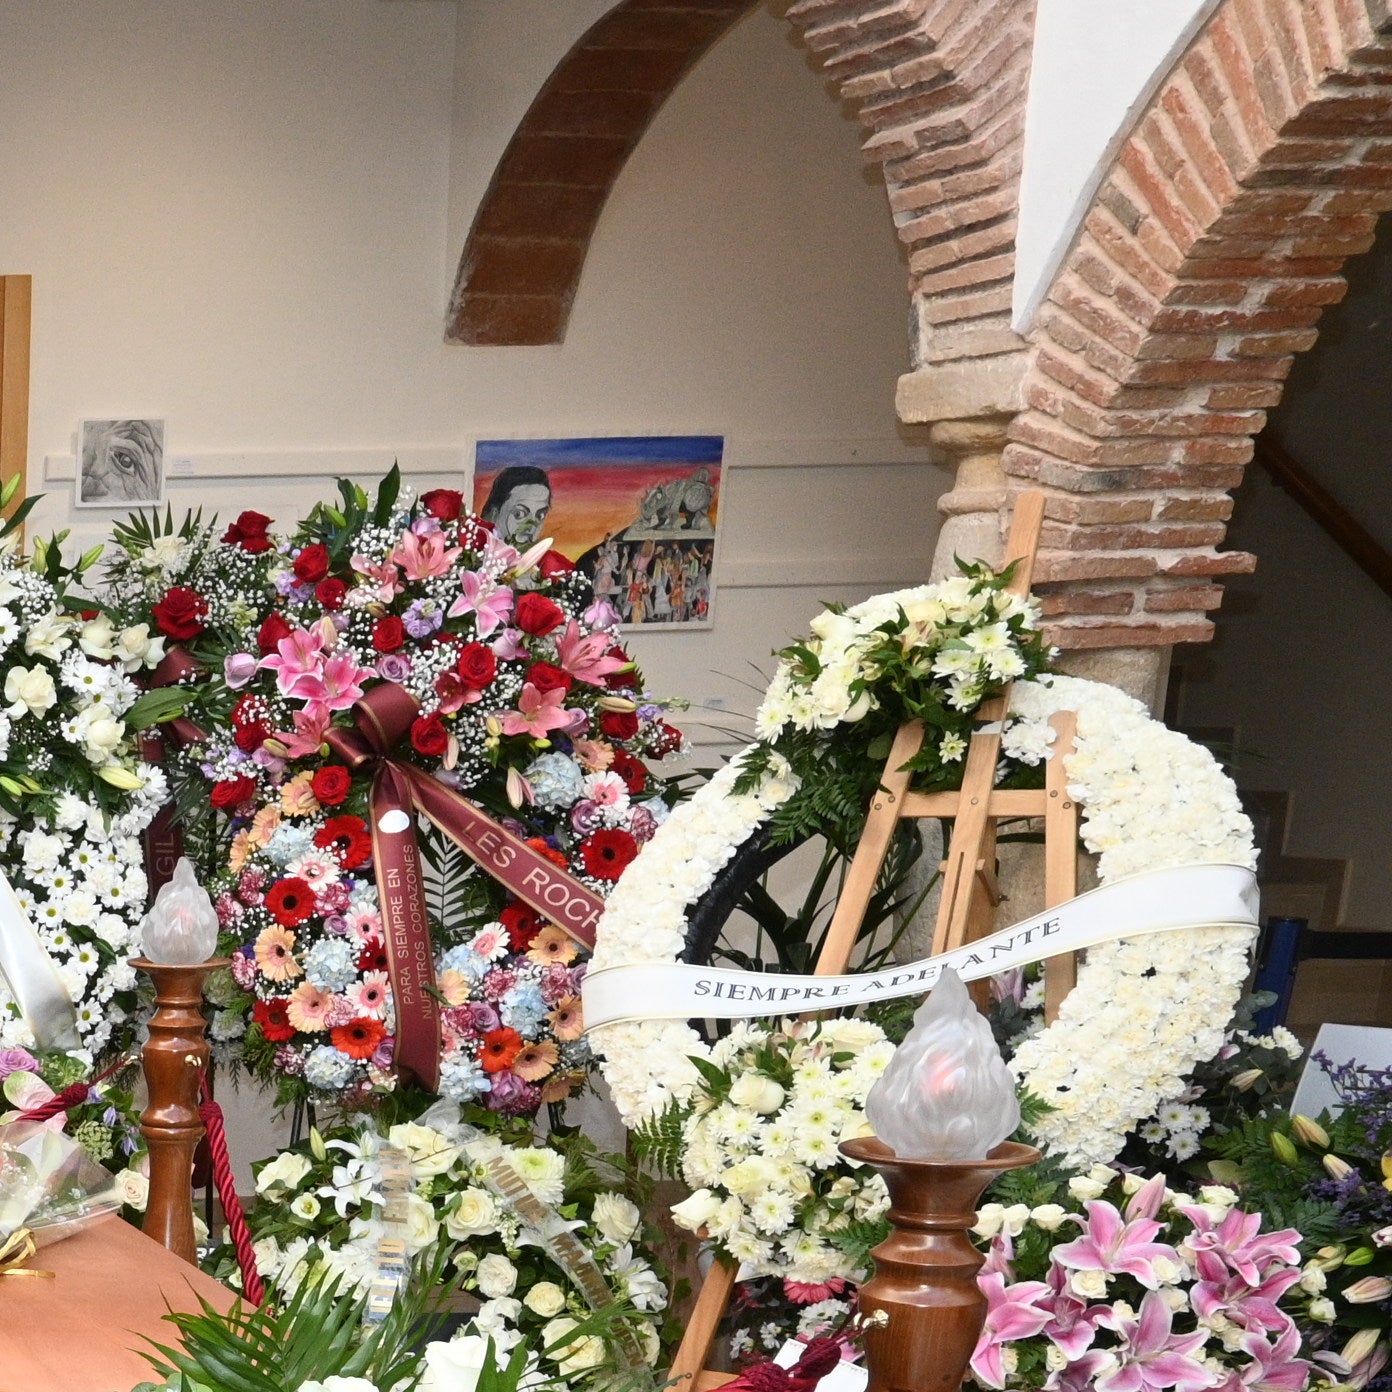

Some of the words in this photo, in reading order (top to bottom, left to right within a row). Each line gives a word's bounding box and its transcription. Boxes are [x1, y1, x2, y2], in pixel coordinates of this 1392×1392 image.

[154, 833, 175, 876] GIL
[462, 820, 516, 869] LES
[386, 868, 402, 890] EN
[402, 844, 424, 934] CORAZONES
[389, 895, 409, 959] SIEMPRE
[398, 965, 415, 1006] PARA
[413, 940, 435, 1020] NUESTROS
[693, 979, 851, 1002] SIEMPRE
